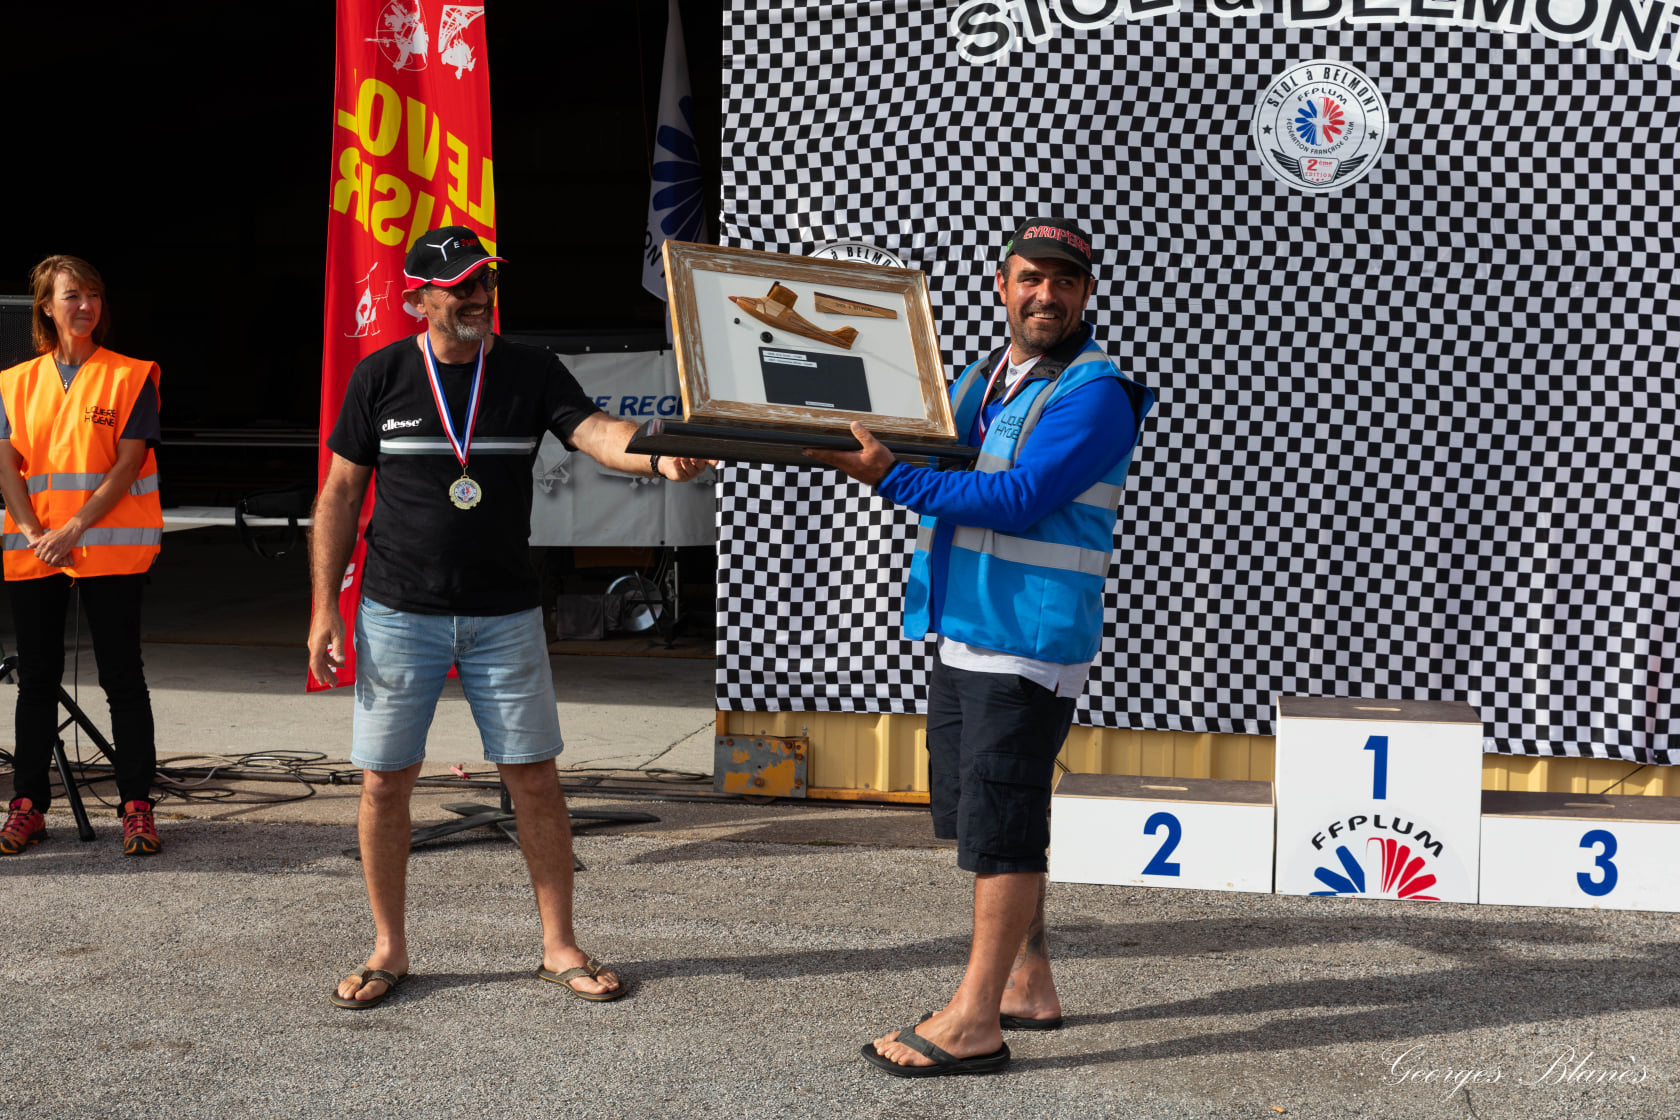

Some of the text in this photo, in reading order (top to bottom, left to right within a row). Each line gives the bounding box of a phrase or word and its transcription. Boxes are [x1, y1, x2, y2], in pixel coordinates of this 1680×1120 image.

[1267, 67, 1379, 113] STOL à BELMONT
[1297, 87, 1348, 105] FFPLUM
[382, 418, 422, 432] ellesse
[1363, 735, 1389, 800] 1
[1141, 811, 1182, 877] 2
[1311, 814, 1443, 858] FFPLUM
[1576, 829, 1619, 897] 3
